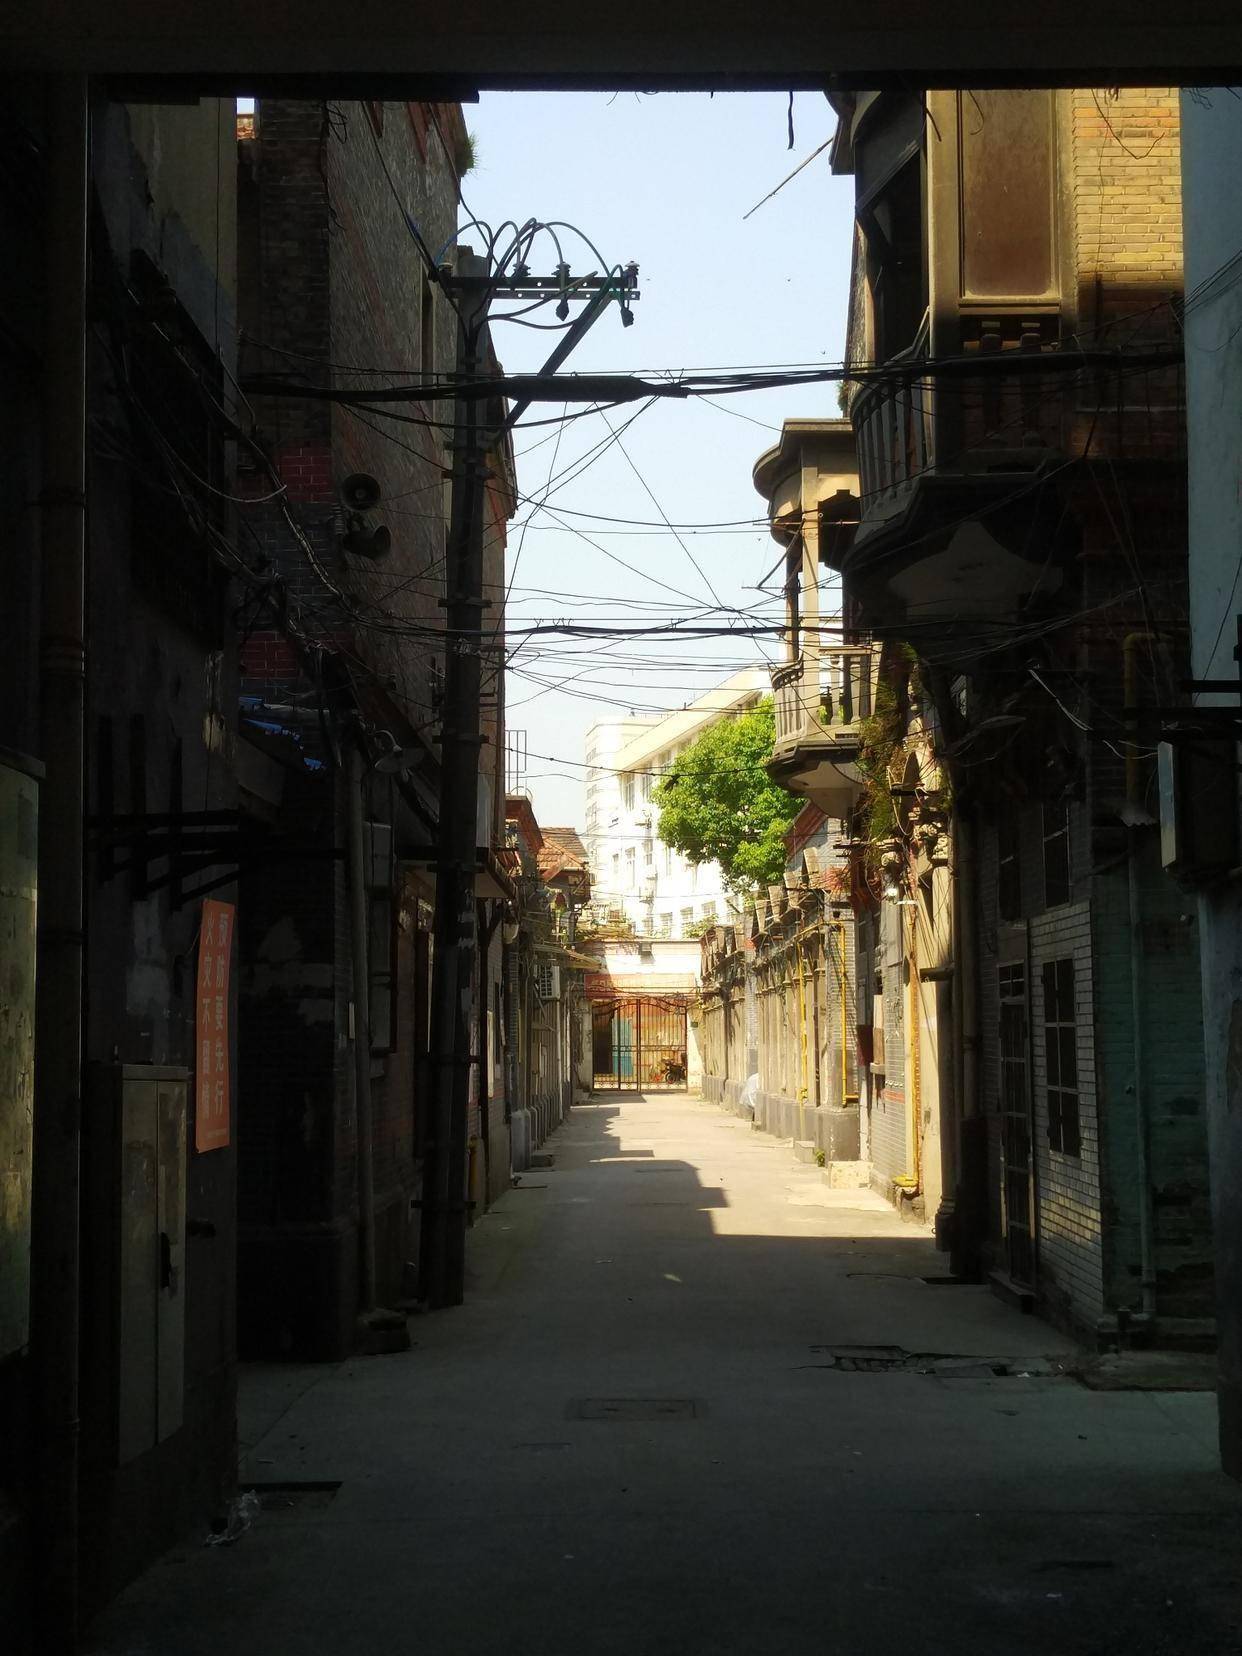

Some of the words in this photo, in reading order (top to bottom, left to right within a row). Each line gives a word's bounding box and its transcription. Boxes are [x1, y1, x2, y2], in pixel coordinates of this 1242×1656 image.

[214, 913, 229, 1116] 预防要先行
